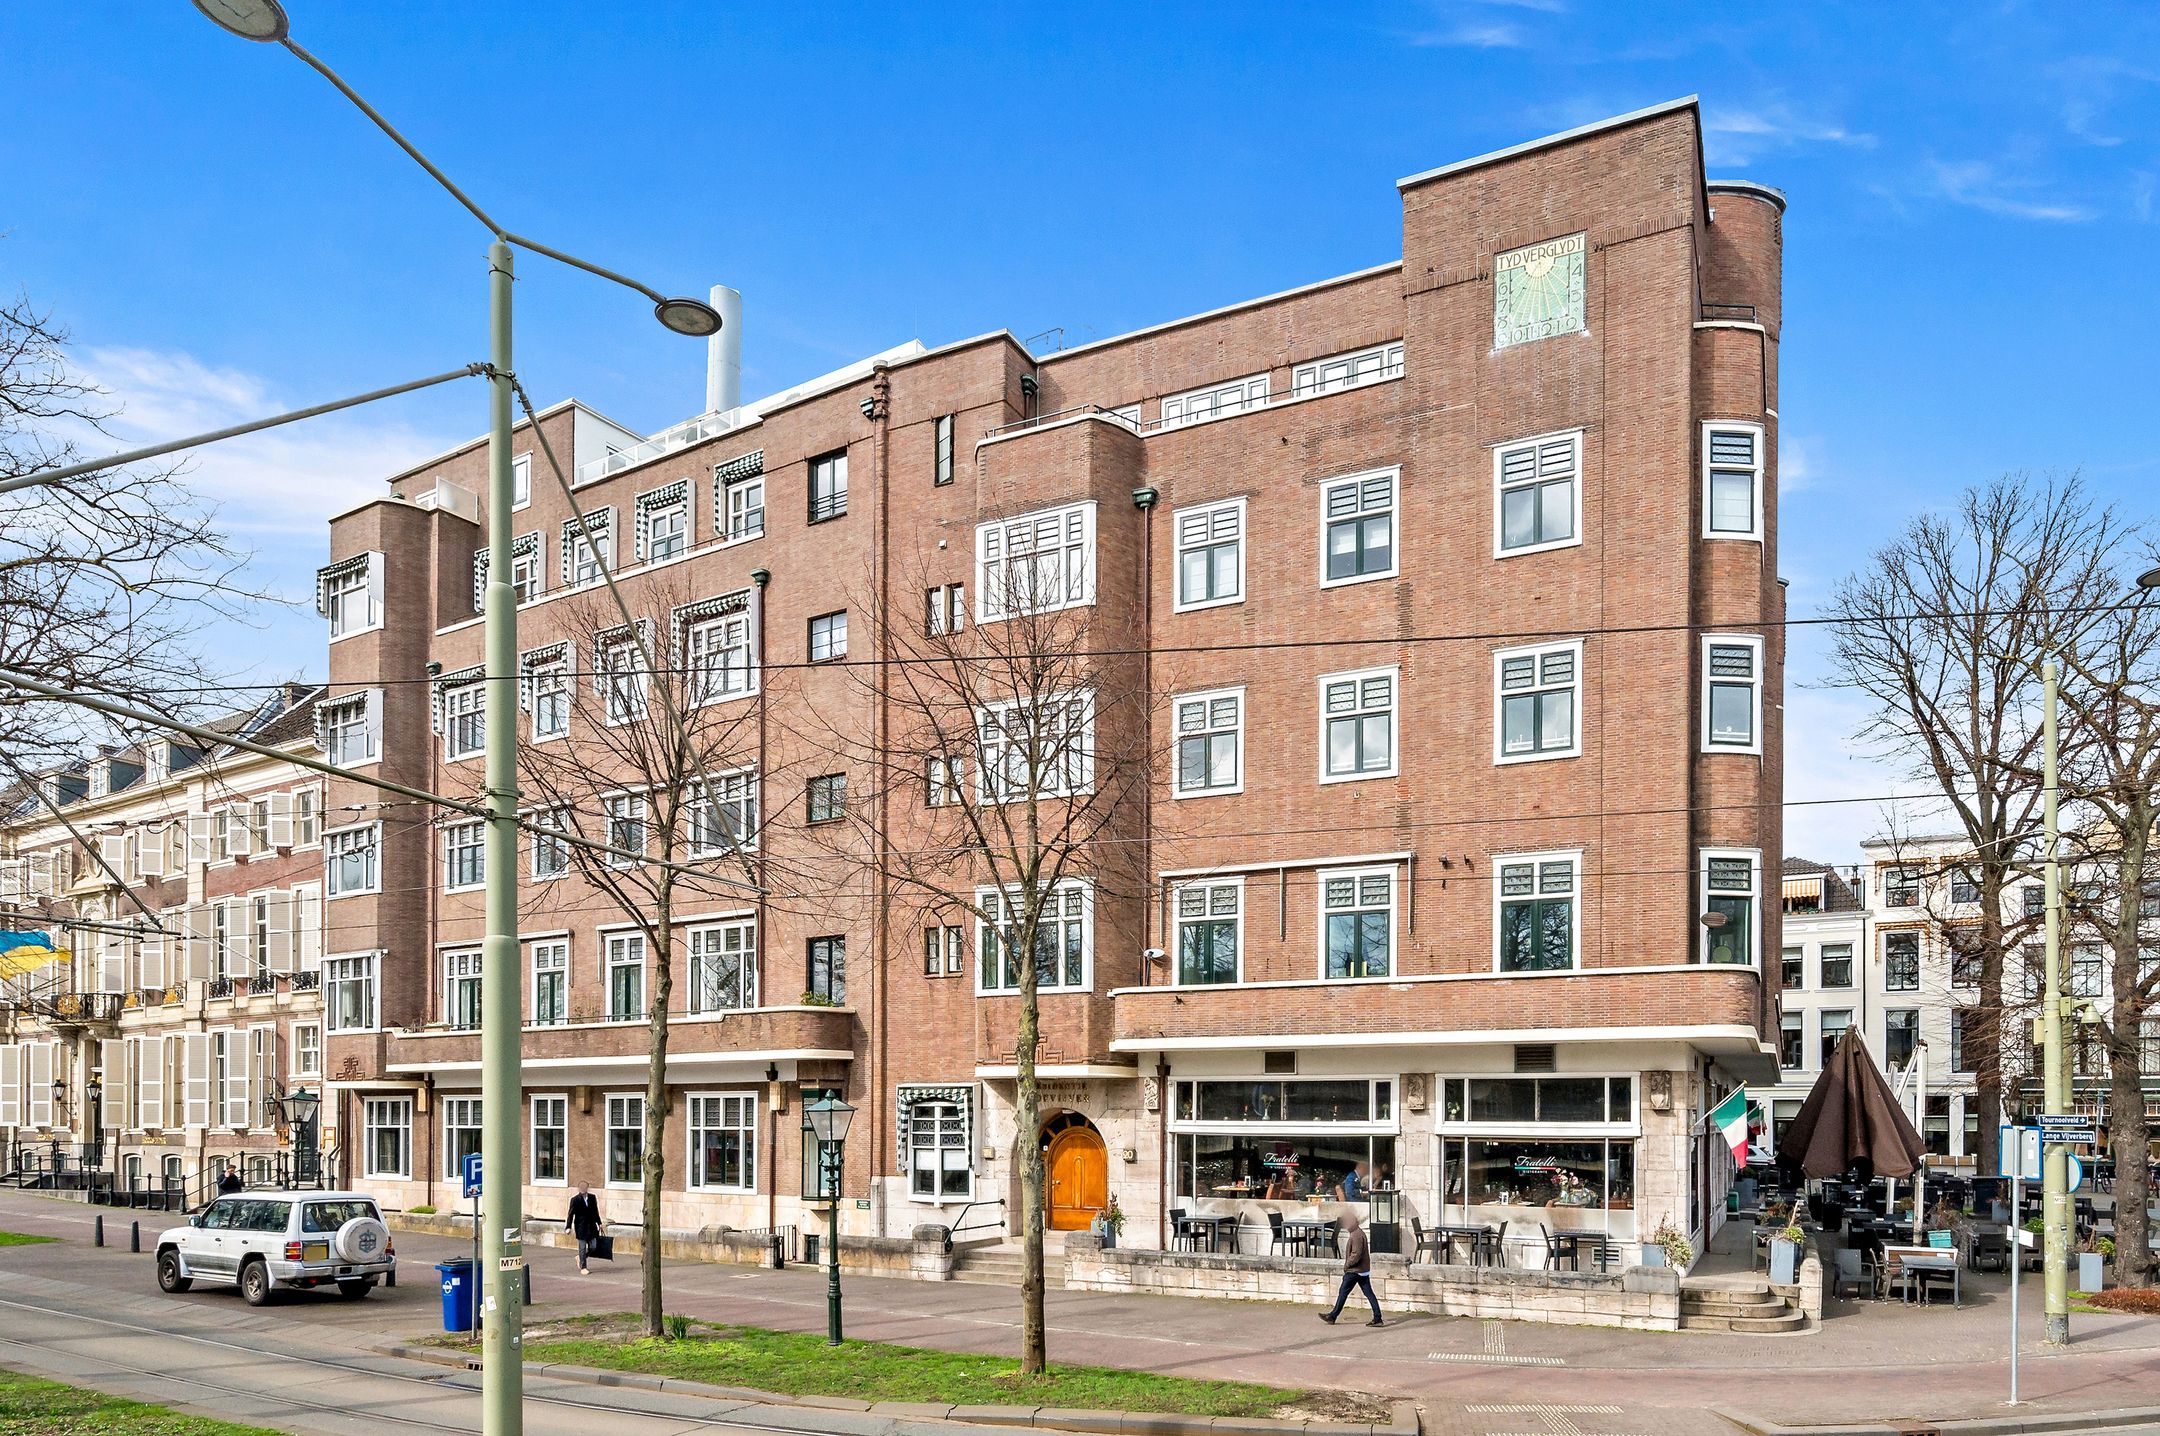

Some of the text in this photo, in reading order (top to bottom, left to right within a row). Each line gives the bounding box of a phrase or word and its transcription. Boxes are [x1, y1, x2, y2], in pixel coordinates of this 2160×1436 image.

[1499, 237, 1582, 270] TYD VERGLYDT
[1572, 263, 1582, 277] 4
[1497, 298, 1508, 313] 7
[2061, 1133, 2093, 1141] Vijverberg
[1263, 1152, 1299, 1163] Fratelli
[1514, 1155, 1556, 1167] Fratelli
[471, 1159, 483, 1180] P
